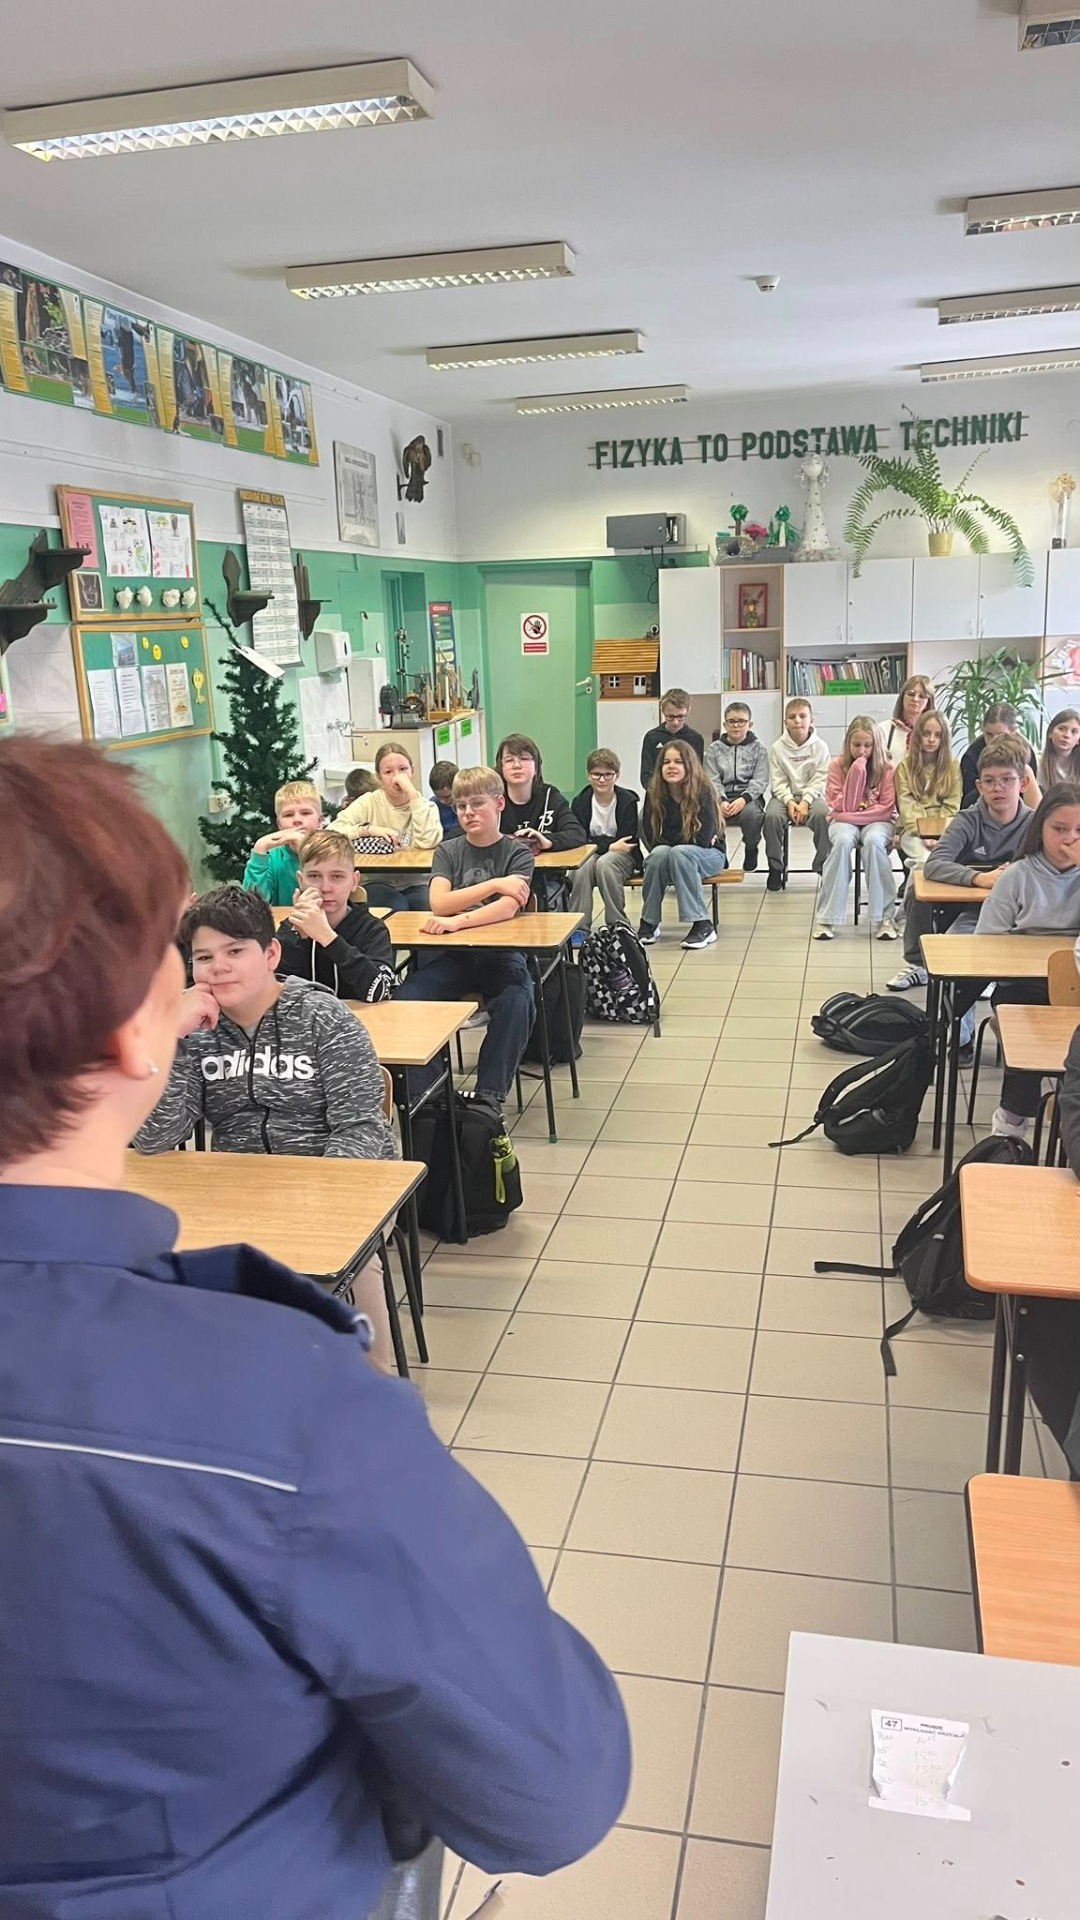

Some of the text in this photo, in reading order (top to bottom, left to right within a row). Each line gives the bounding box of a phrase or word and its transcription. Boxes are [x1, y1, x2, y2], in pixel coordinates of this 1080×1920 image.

[595, 436, 683, 470] FIZYKA
[698, 433, 729, 463] TO
[742, 424, 878, 461] PODSTAWA
[201, 1046, 315, 1081] adidas
[885, 1720, 898, 1728] 47
